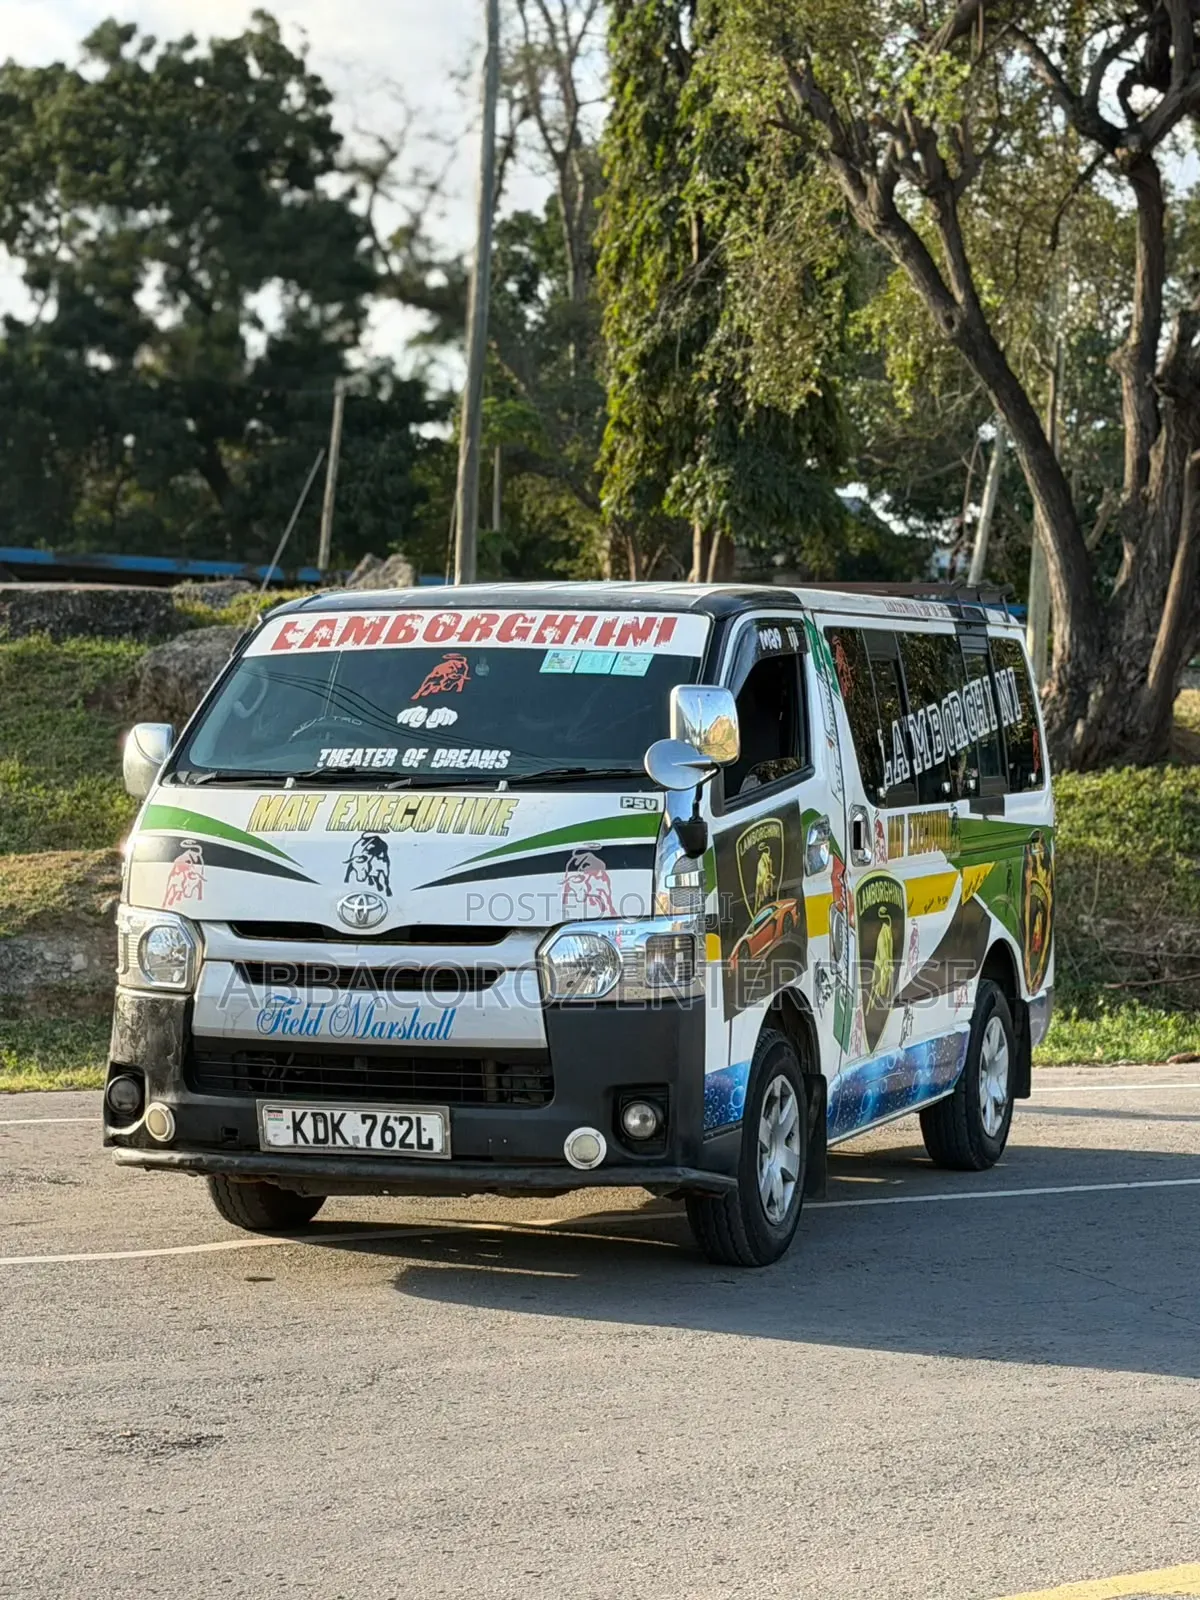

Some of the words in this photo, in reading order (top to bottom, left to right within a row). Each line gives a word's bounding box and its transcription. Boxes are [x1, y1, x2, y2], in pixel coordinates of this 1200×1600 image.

[317, 748, 398, 768] THEATER
[402, 748, 429, 768] OF
[430, 749, 511, 769] DREAMS
[246, 794, 326, 832] MAT
[326, 794, 520, 837] EXECUTIVE
[621, 797, 657, 810] PSV
[256, 992, 324, 1037] Field
[328, 992, 457, 1041] Marshall
[291, 1110, 350, 1146] KDK
[360, 1113, 434, 1151] 762L
